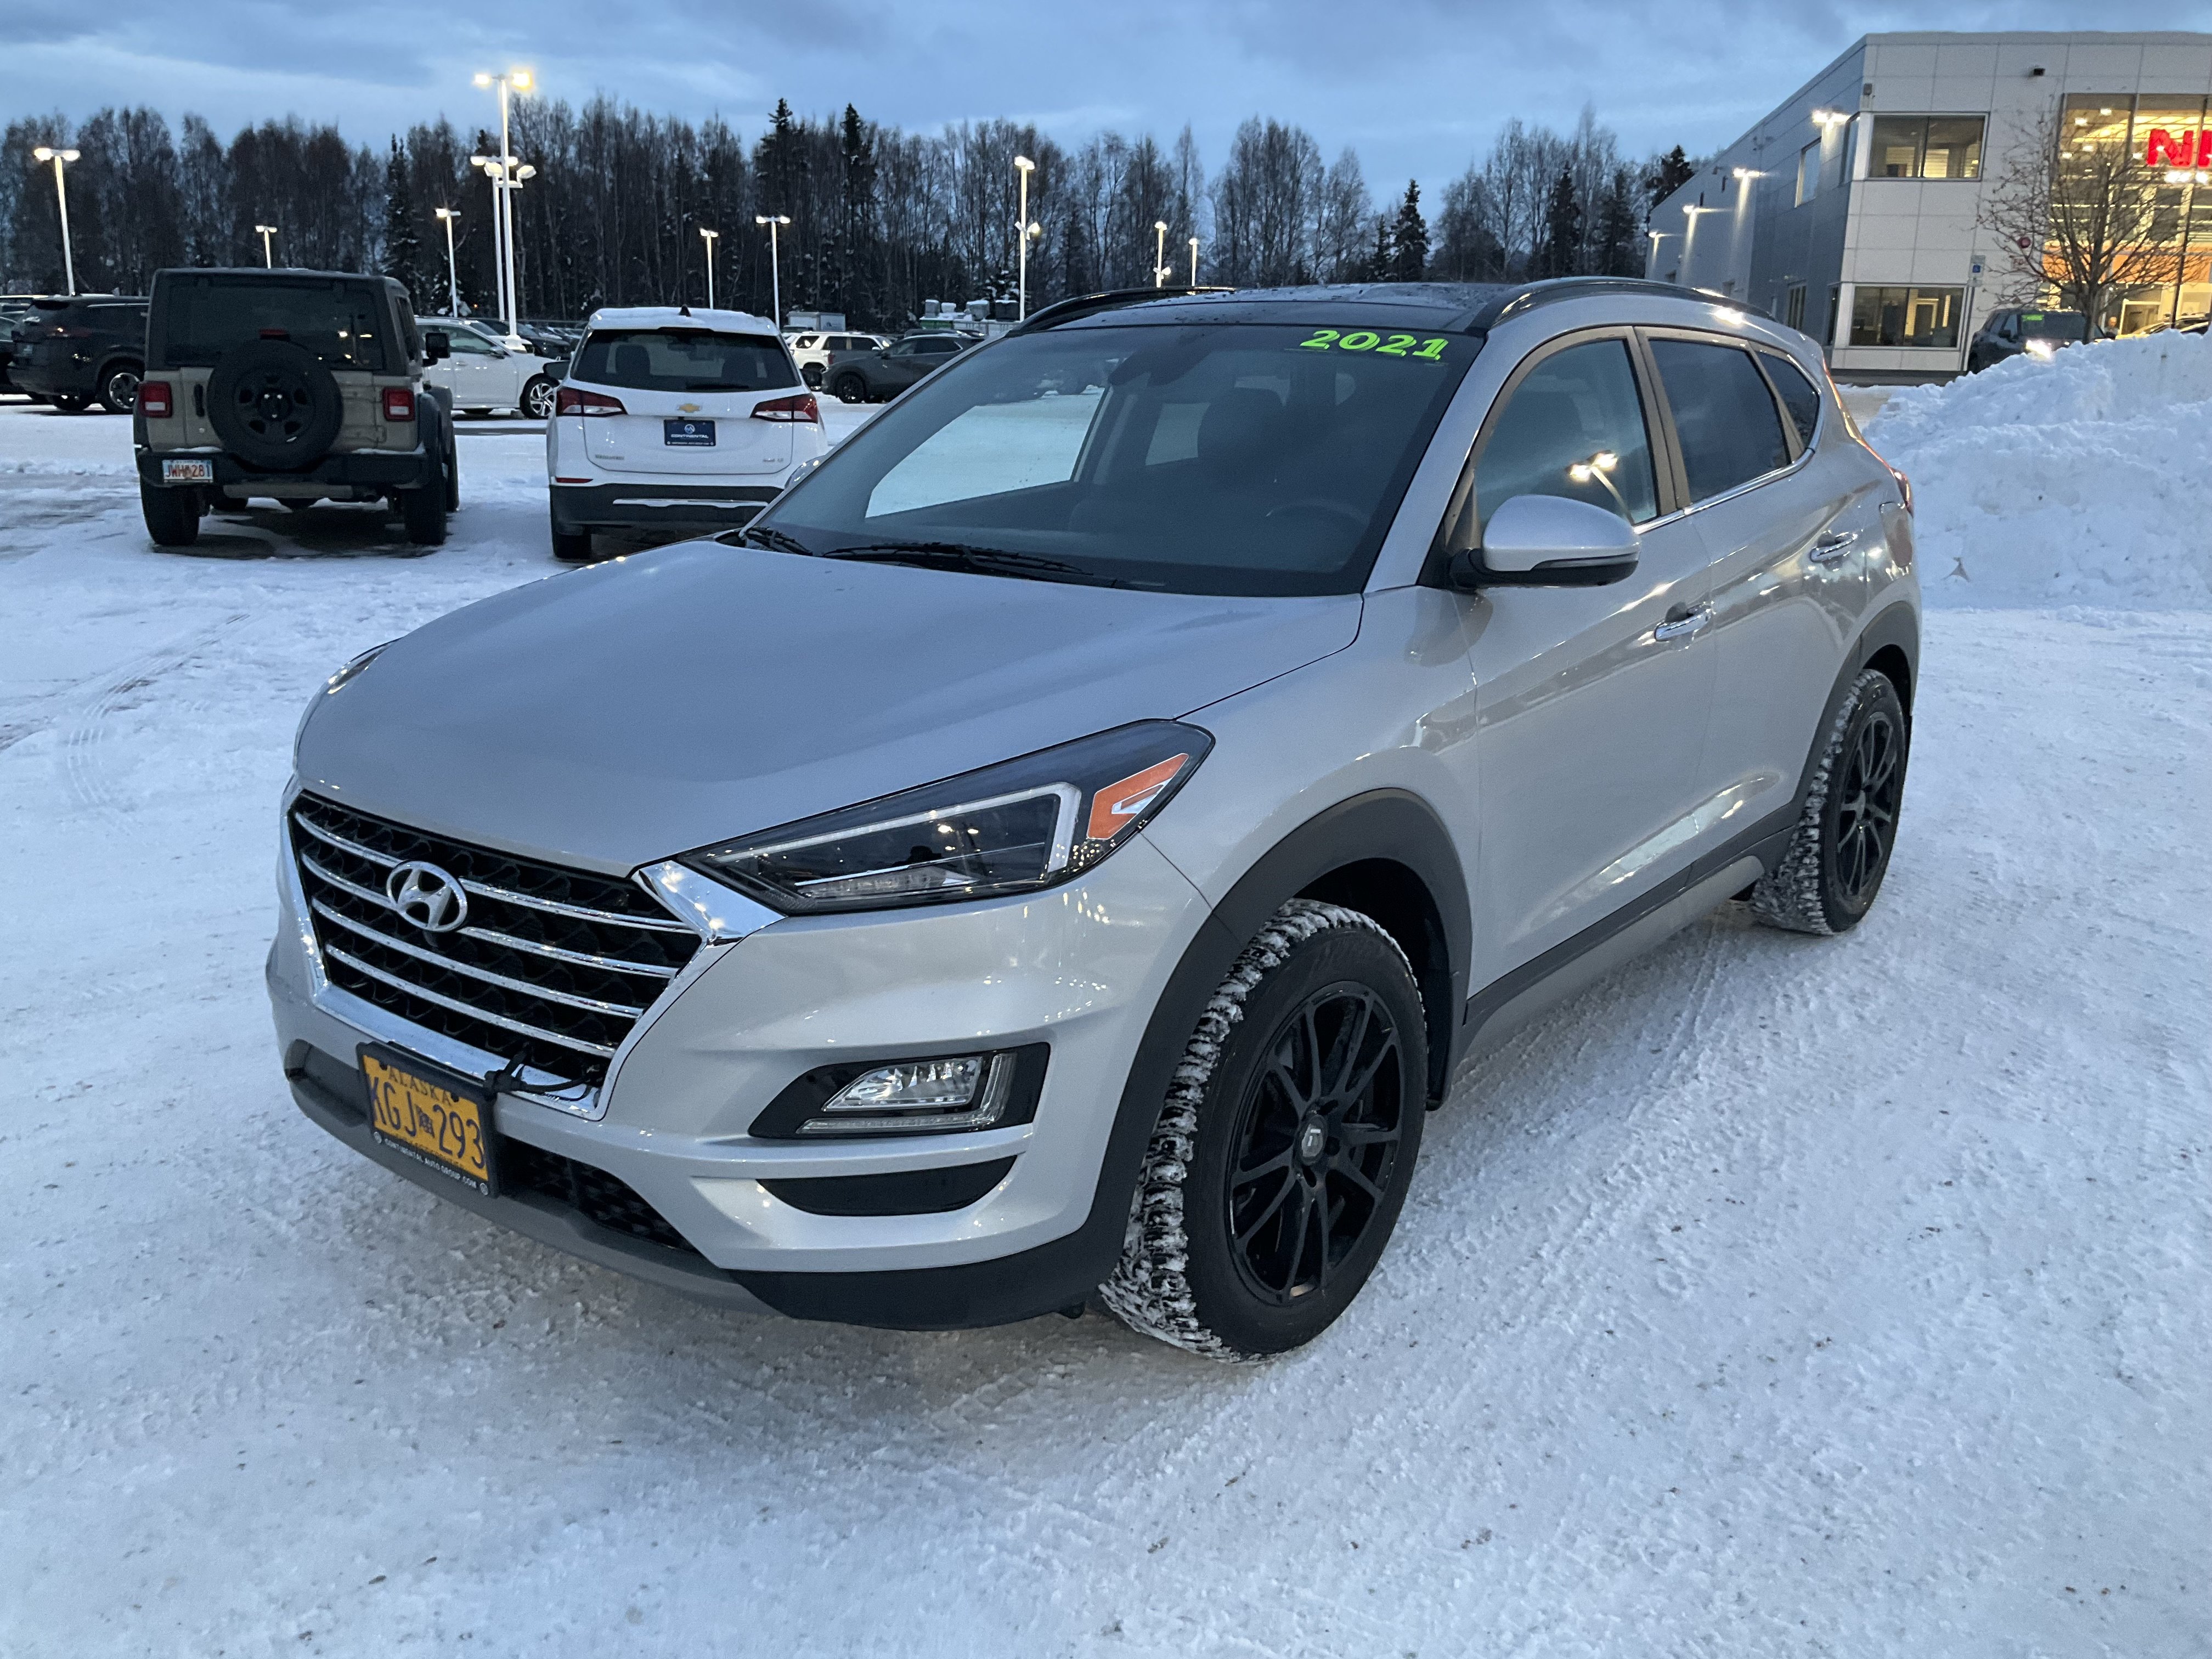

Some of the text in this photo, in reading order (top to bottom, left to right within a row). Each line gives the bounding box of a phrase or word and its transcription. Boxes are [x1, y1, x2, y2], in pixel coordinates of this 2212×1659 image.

[1300, 330, 1449, 360] 2021
[389, 1067, 452, 1106] ALASKA
[433, 1104, 485, 1169] 293
